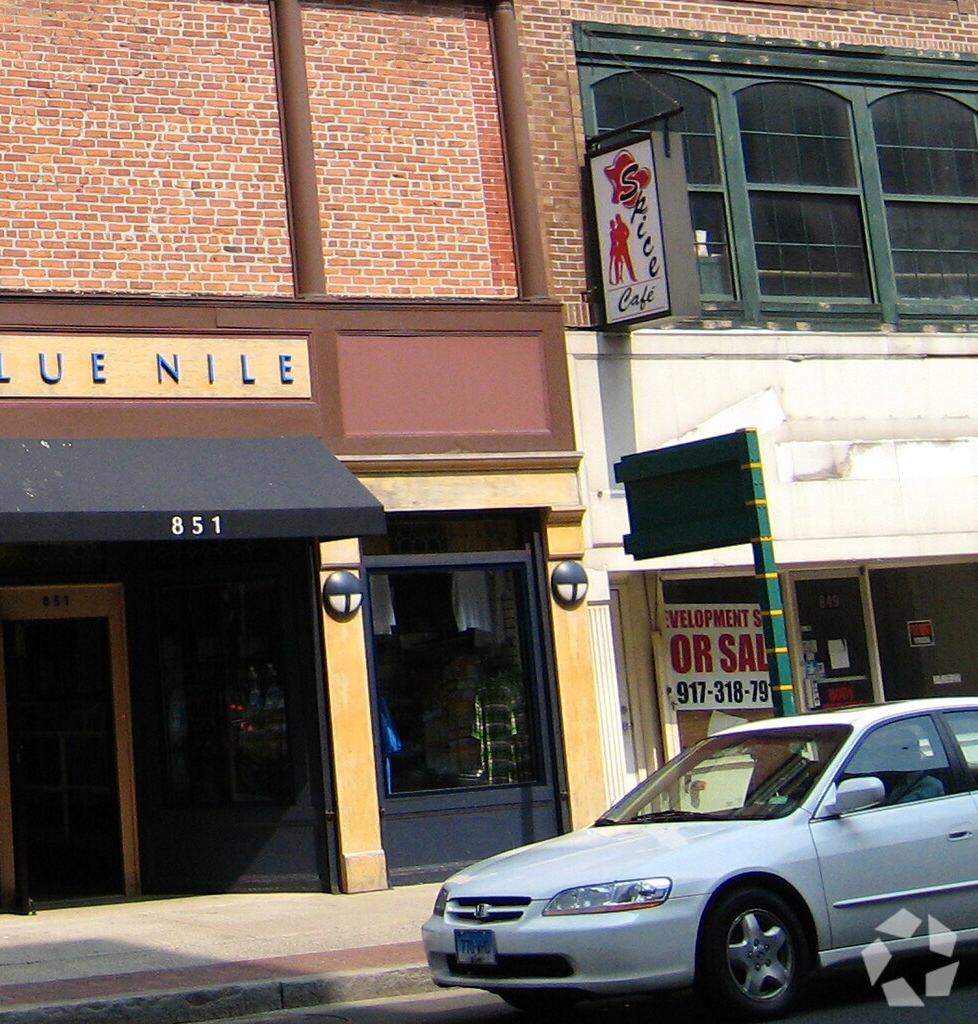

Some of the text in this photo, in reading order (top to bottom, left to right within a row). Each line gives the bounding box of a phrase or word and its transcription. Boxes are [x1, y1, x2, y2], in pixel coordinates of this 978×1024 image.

[619, 163, 660, 277] Spice
[617, 285, 656, 312] Café
[156, 352, 295, 384] NILE
[171, 516, 222, 535] 851
[665, 608, 763, 629] VELOPMENT S
[670, 632, 770, 674] OR SAL
[676, 679, 772, 704] 917-318-79
